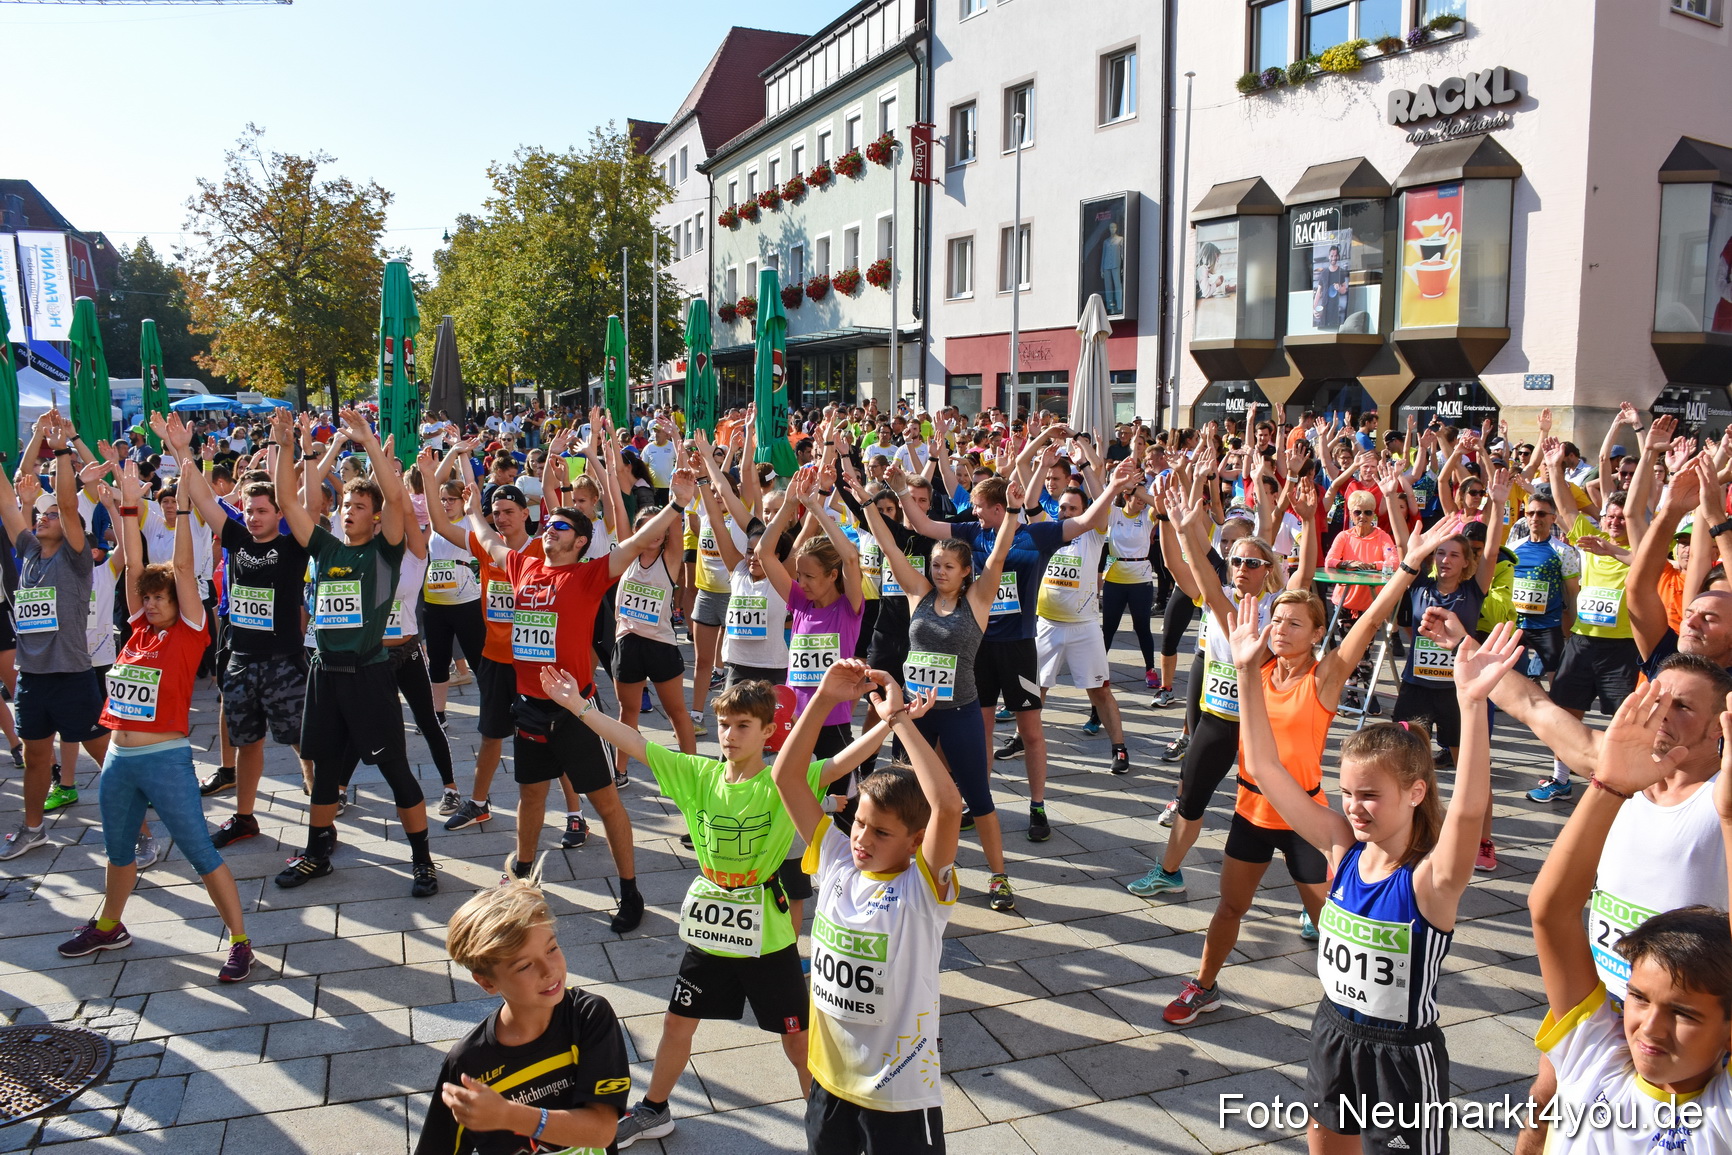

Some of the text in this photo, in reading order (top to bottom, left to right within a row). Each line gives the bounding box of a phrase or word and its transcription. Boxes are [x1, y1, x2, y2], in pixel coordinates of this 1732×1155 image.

[1388, 66, 1518, 125] RACKL
[1406, 112, 1507, 143] am Rathaus
[915, 135, 927, 178] Achatz
[1298, 206, 1334, 223] 100 Jahre
[1295, 220, 1327, 244] RACKL
[18, 348, 37, 364] PATL
[1226, 398, 1245, 411] RACKL
[1437, 401, 1463, 415] RACKL
[1653, 404, 1679, 413] Willkommen
[1685, 401, 1707, 421] RACKL
[431, 561, 452, 569] OCK
[1047, 565, 1077, 579] 5240
[319, 581, 356, 595] BOCK
[490, 583, 514, 593] BOC
[625, 580, 662, 597] BOCK
[1048, 579, 1073, 587] MARKUS
[233, 585, 269, 600] BOCK
[1513, 589, 1542, 603] 5212
[234, 600, 268, 617] 2106
[319, 597, 355, 613] 2105
[490, 595, 515, 609] 210
[624, 594, 657, 613] 2111
[1580, 598, 1614, 614] 2206
[18, 602, 50, 619] 2099
[626, 609, 649, 621] CELINA
[728, 610, 760, 625] 2101
[1582, 613, 1608, 623] ERT
[237, 616, 264, 627] NICOLAI
[322, 616, 349, 625] ANTON
[515, 612, 553, 626] BOCK
[514, 627, 550, 645] 2110
[792, 635, 834, 649] BOCK
[792, 651, 834, 669] 2616
[910, 653, 951, 667] BOCK
[118, 666, 153, 682] OCK
[793, 672, 825, 681] SUSANN
[908, 665, 948, 685] 2112
[1418, 667, 1454, 677] VERONIK
[109, 680, 151, 703] 2070
[1209, 677, 1239, 699] 266
[113, 701, 143, 715] RION
[689, 902, 753, 931] 4026
[1599, 897, 1650, 927] BOC
[1325, 906, 1396, 947] BOCK
[687, 927, 753, 947] LEONHARD
[817, 916, 878, 958] BOCK
[1323, 937, 1394, 986] 4013
[814, 946, 875, 994] 4006
[674, 984, 692, 1007] 13
[813, 983, 876, 1015] JOHANNES
[1335, 980, 1368, 1004] LISA
[889, 1049, 918, 1078] September
[915, 1037, 928, 1053] 2019
[1387, 1142, 1410, 1150] adidas
